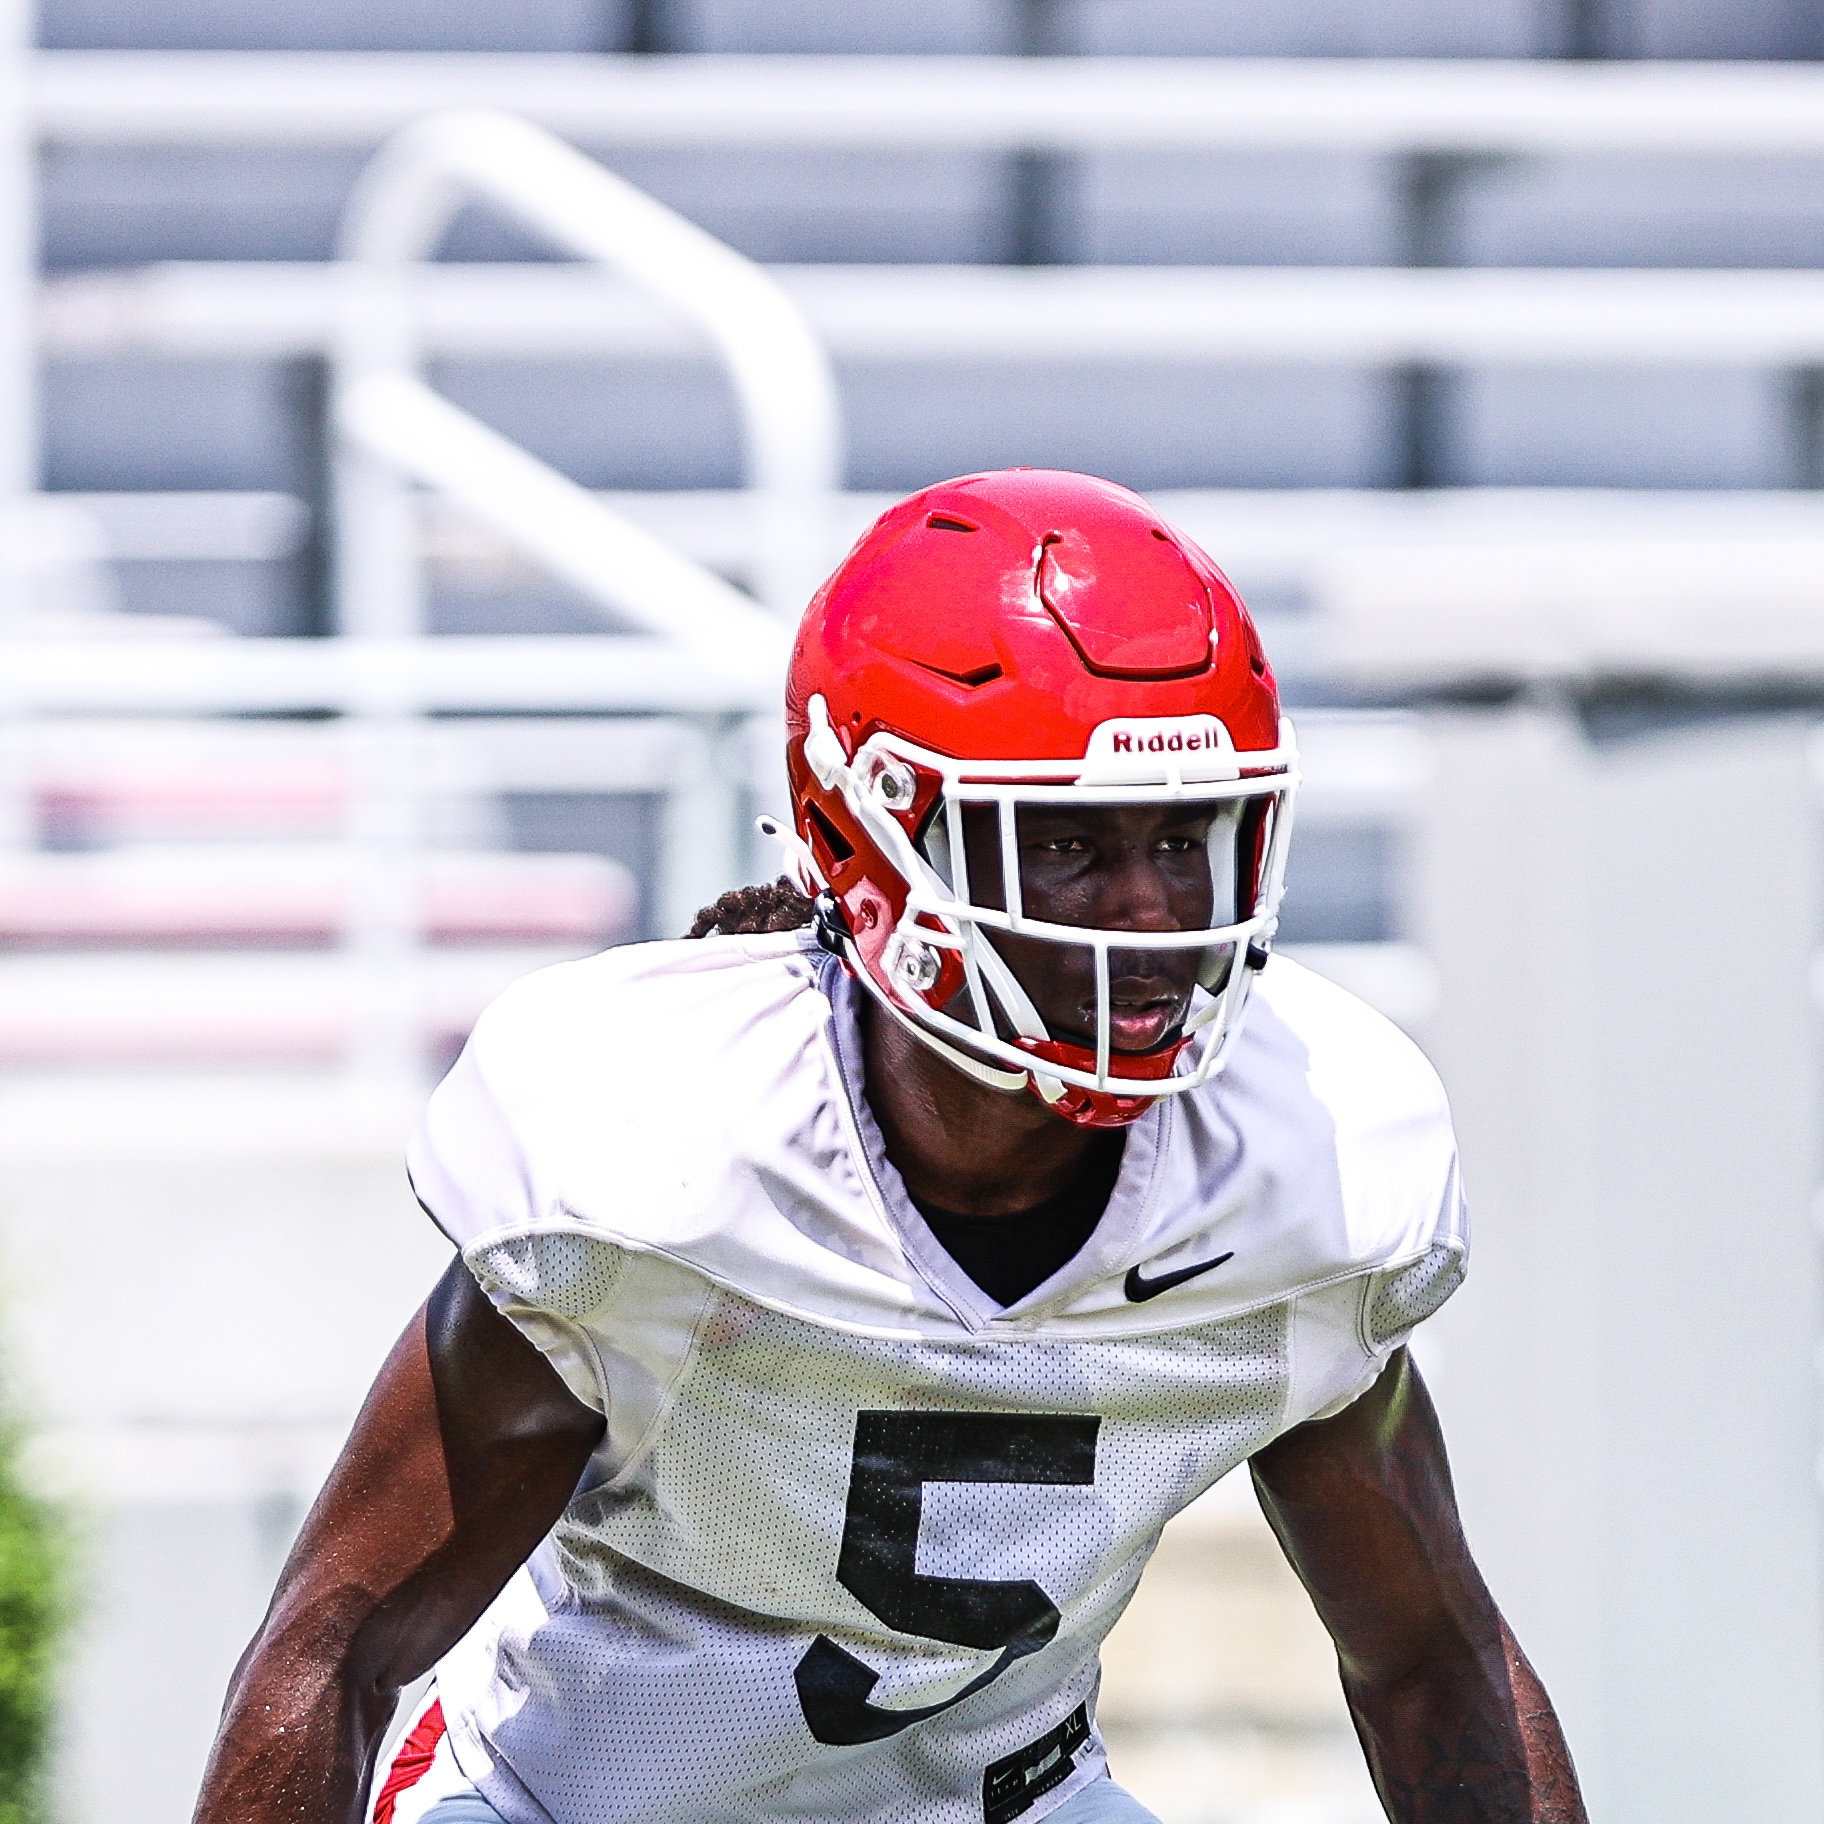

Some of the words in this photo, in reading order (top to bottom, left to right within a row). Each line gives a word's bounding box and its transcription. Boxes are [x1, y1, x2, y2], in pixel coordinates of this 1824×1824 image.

[1112, 727, 1219, 753] Riddell
[793, 1409, 1102, 1745] 5
[1065, 1712, 1082, 1739] XL
